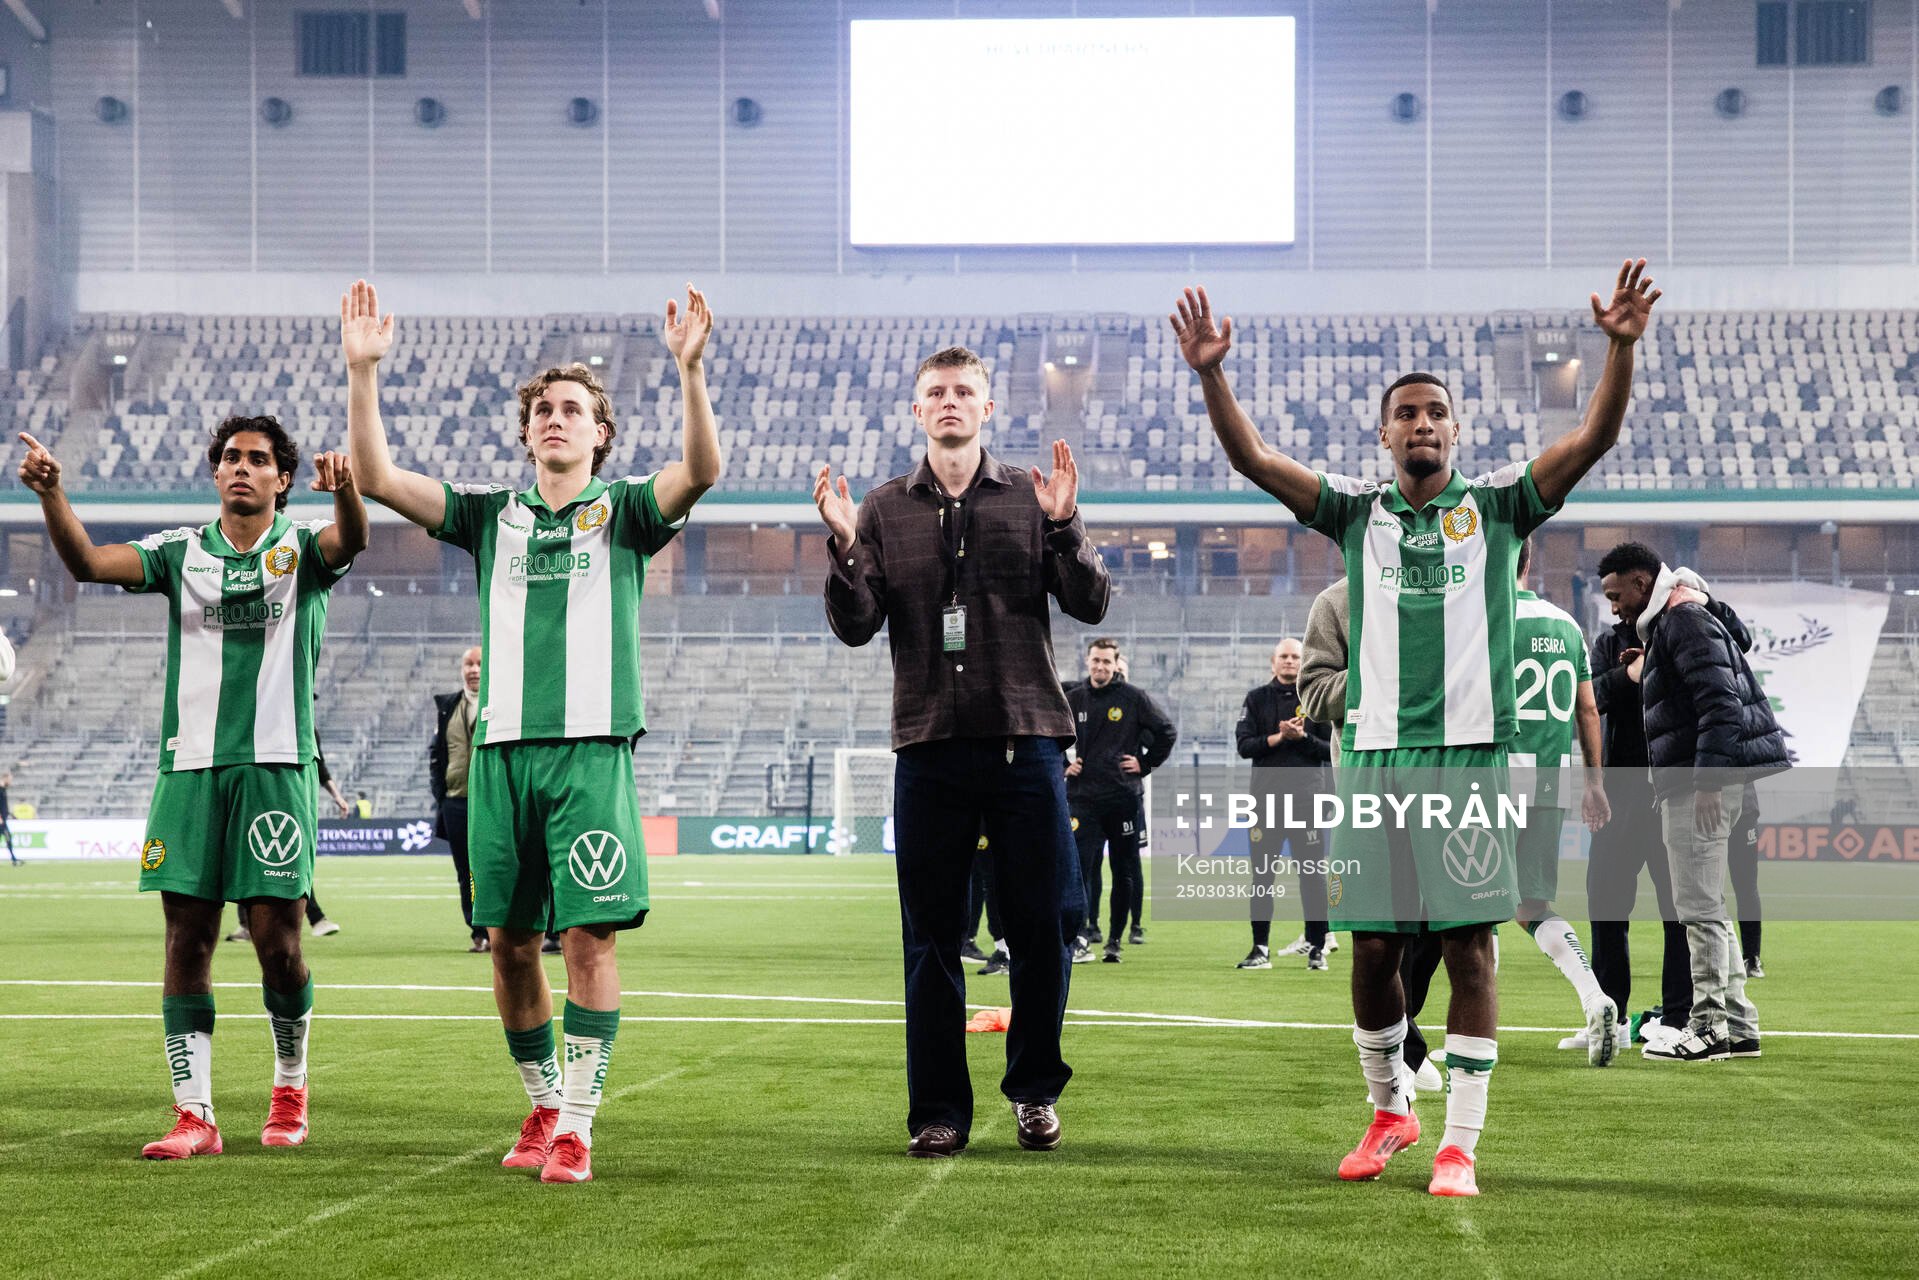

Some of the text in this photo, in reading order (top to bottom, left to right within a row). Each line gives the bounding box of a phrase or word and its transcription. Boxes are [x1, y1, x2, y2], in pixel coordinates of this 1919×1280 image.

[1372, 520, 1393, 528] CRAFT
[1416, 532, 1438, 541] INTER
[509, 552, 591, 574] PROJOB
[1380, 564, 1466, 587] PROJOB
[204, 602, 284, 623] PROJOB
[1531, 637, 1566, 654] BESARA
[1513, 658, 1578, 722] 20
[711, 825, 826, 849] CRAFT
[263, 869, 292, 878] CRAFT
[593, 894, 622, 903] CRAFT
[1471, 890, 1500, 900] CRAFT
